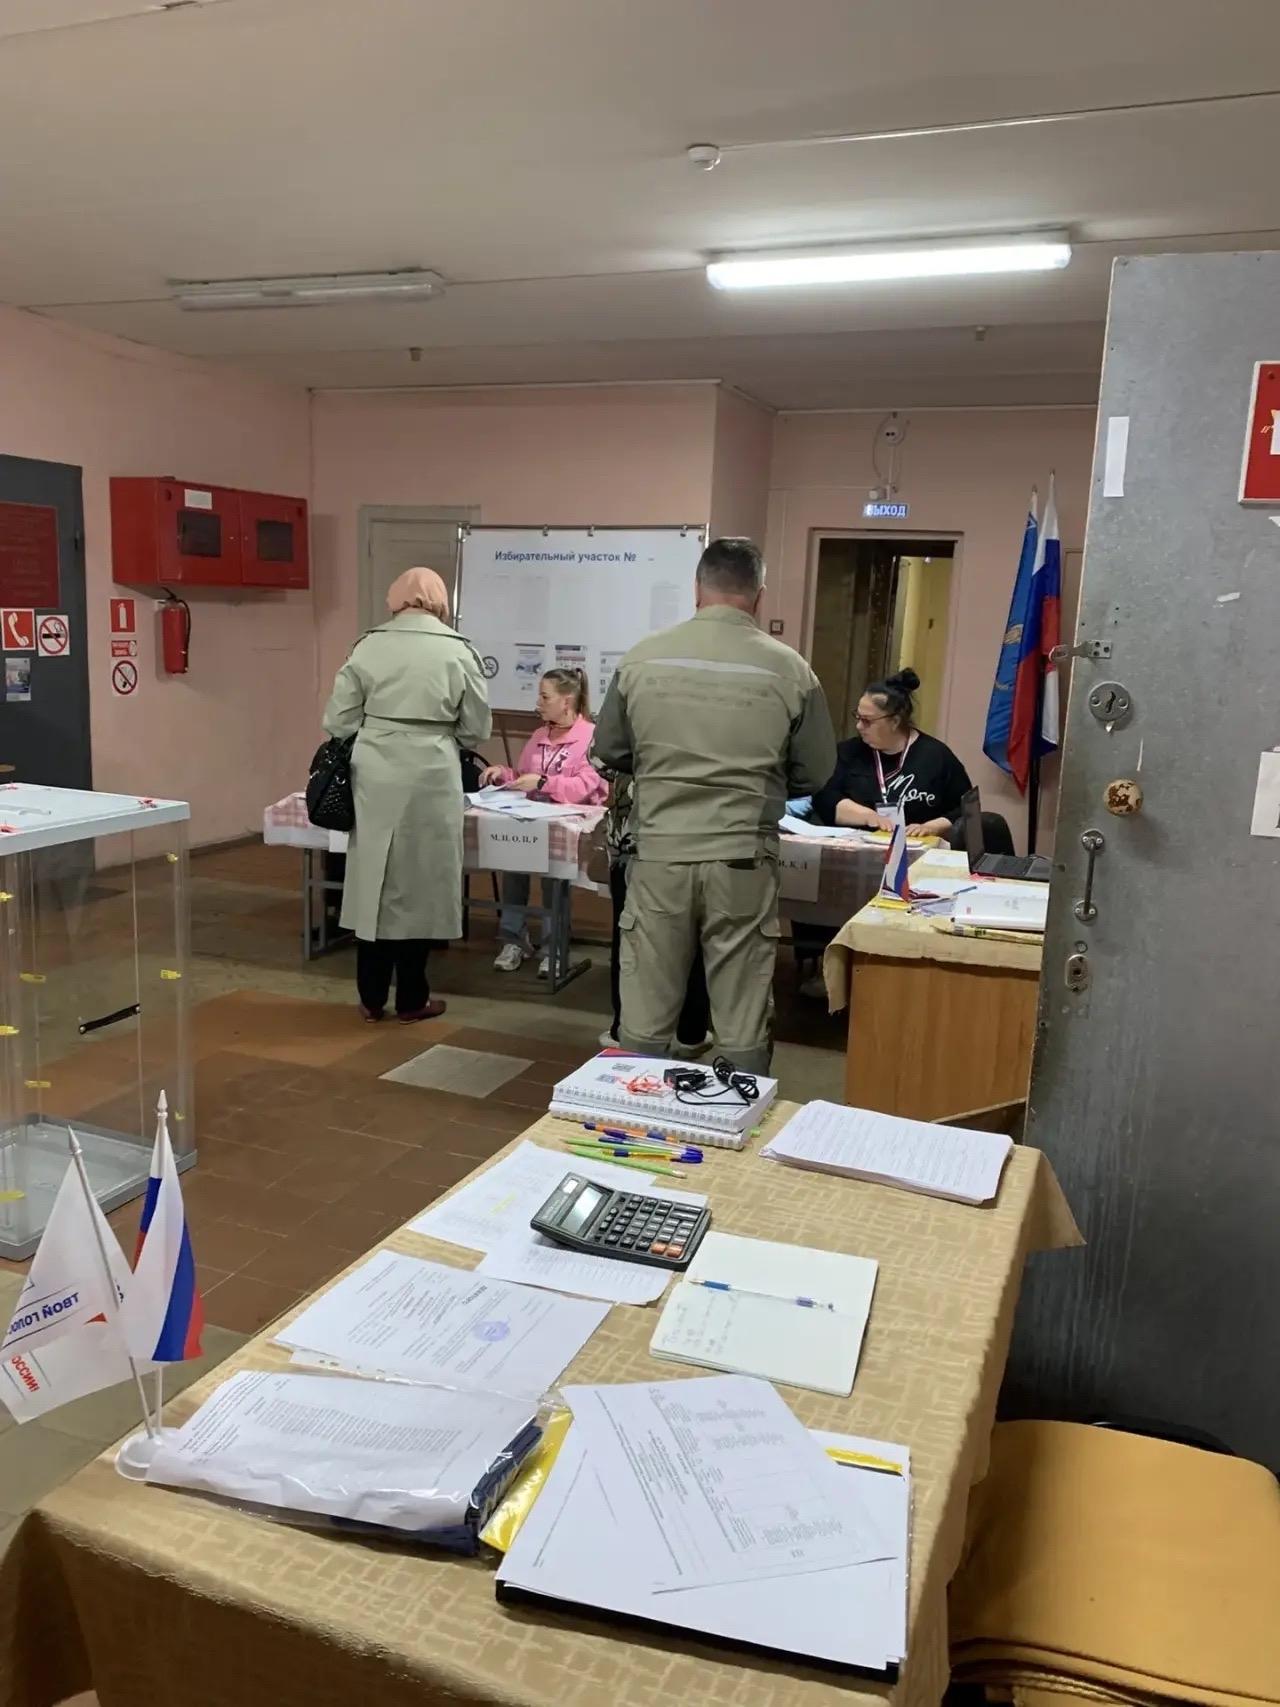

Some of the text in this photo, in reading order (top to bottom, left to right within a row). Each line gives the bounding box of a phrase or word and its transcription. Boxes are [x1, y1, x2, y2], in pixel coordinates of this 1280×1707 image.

[864, 504, 906, 517] ВЫХОД
[495, 551, 636, 563] Избирательный участок №
